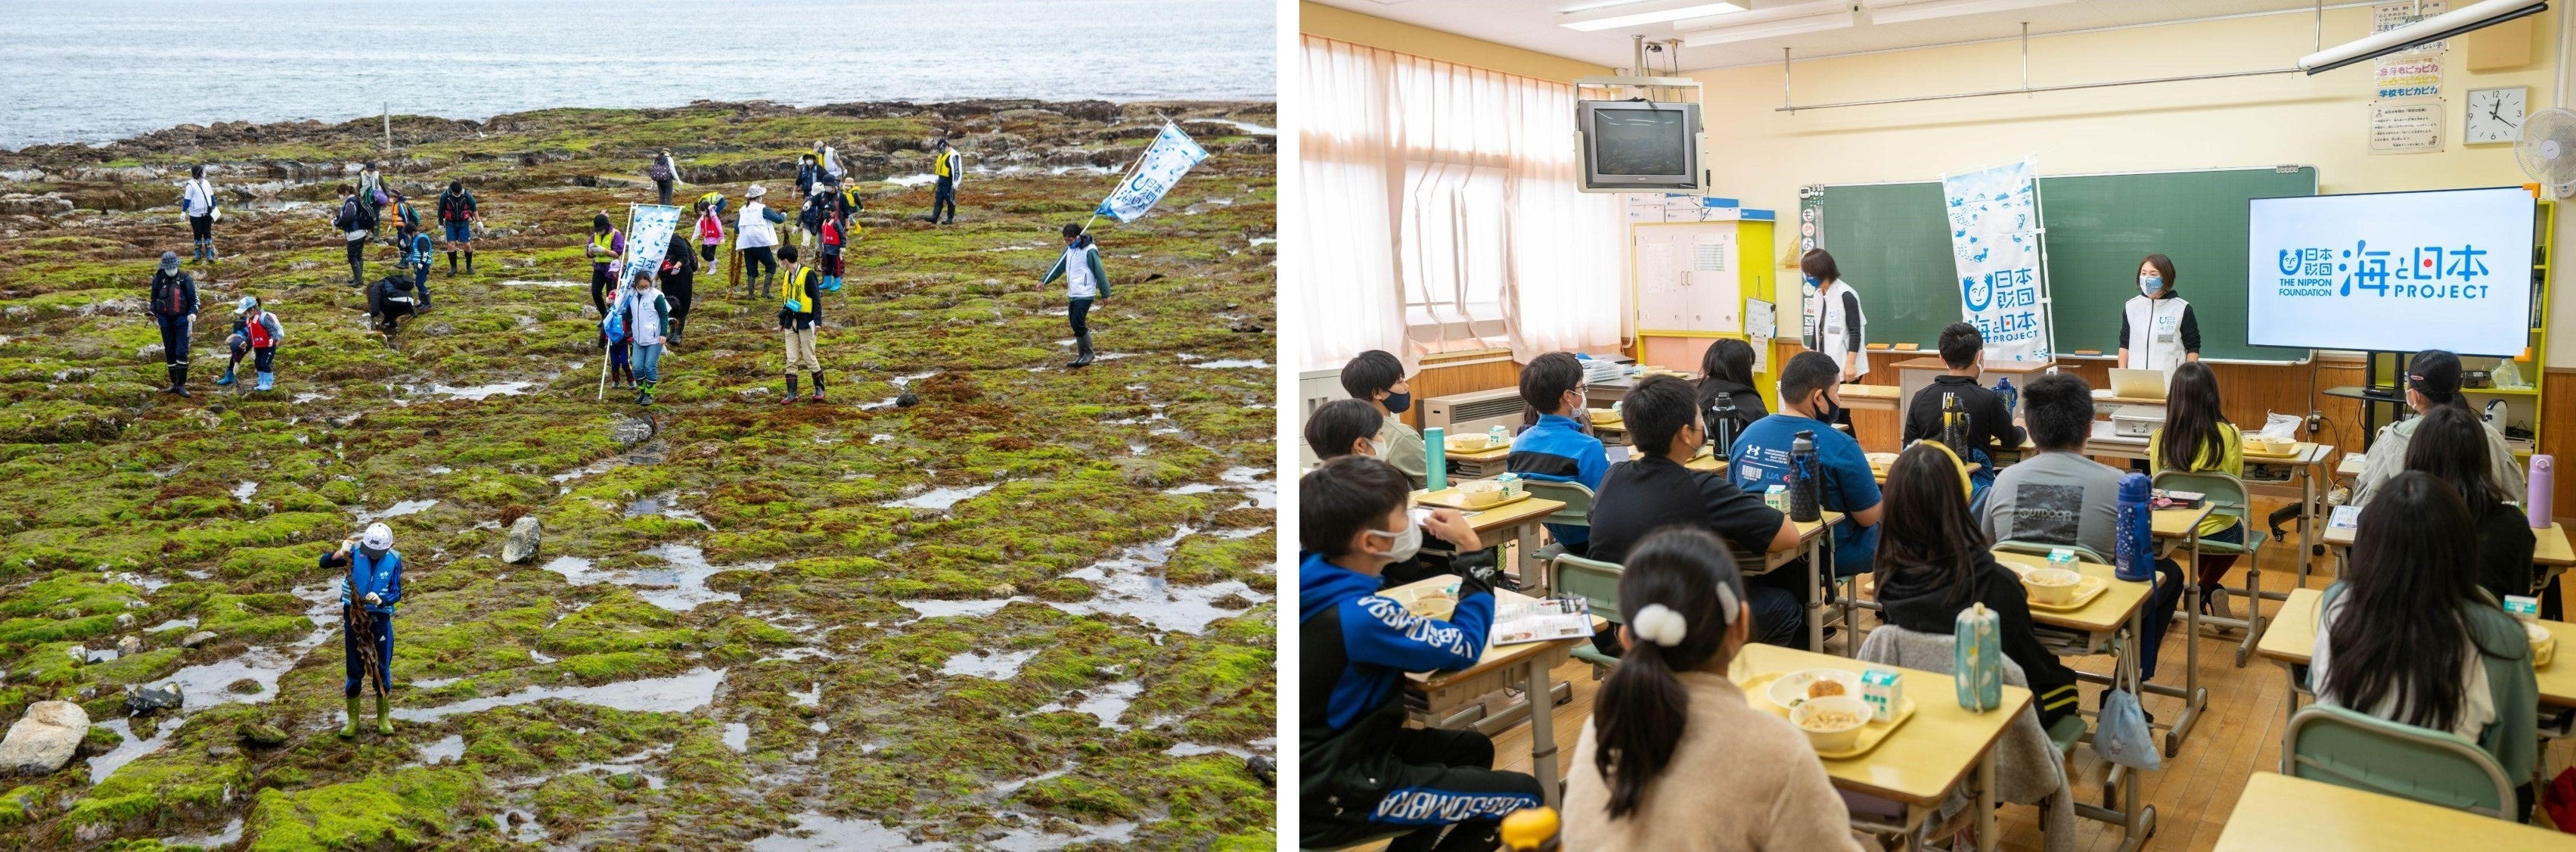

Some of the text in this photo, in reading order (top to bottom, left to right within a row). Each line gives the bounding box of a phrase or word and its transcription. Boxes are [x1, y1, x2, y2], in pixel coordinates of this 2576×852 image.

[2468, 113, 2474, 121] 9
[2304, 247, 2332, 260] 日本
[2304, 263, 2332, 275] 財団
[2339, 239, 2489, 297] 海と日本
[1994, 267, 2033, 288] 日本
[1997, 287, 2035, 309] 財団
[2279, 288, 2332, 297] FOUNDATION
[2394, 284, 2489, 299] PROJECT
[1994, 330, 2038, 343] PROJECT
[1766, 472, 1780, 480] UA
